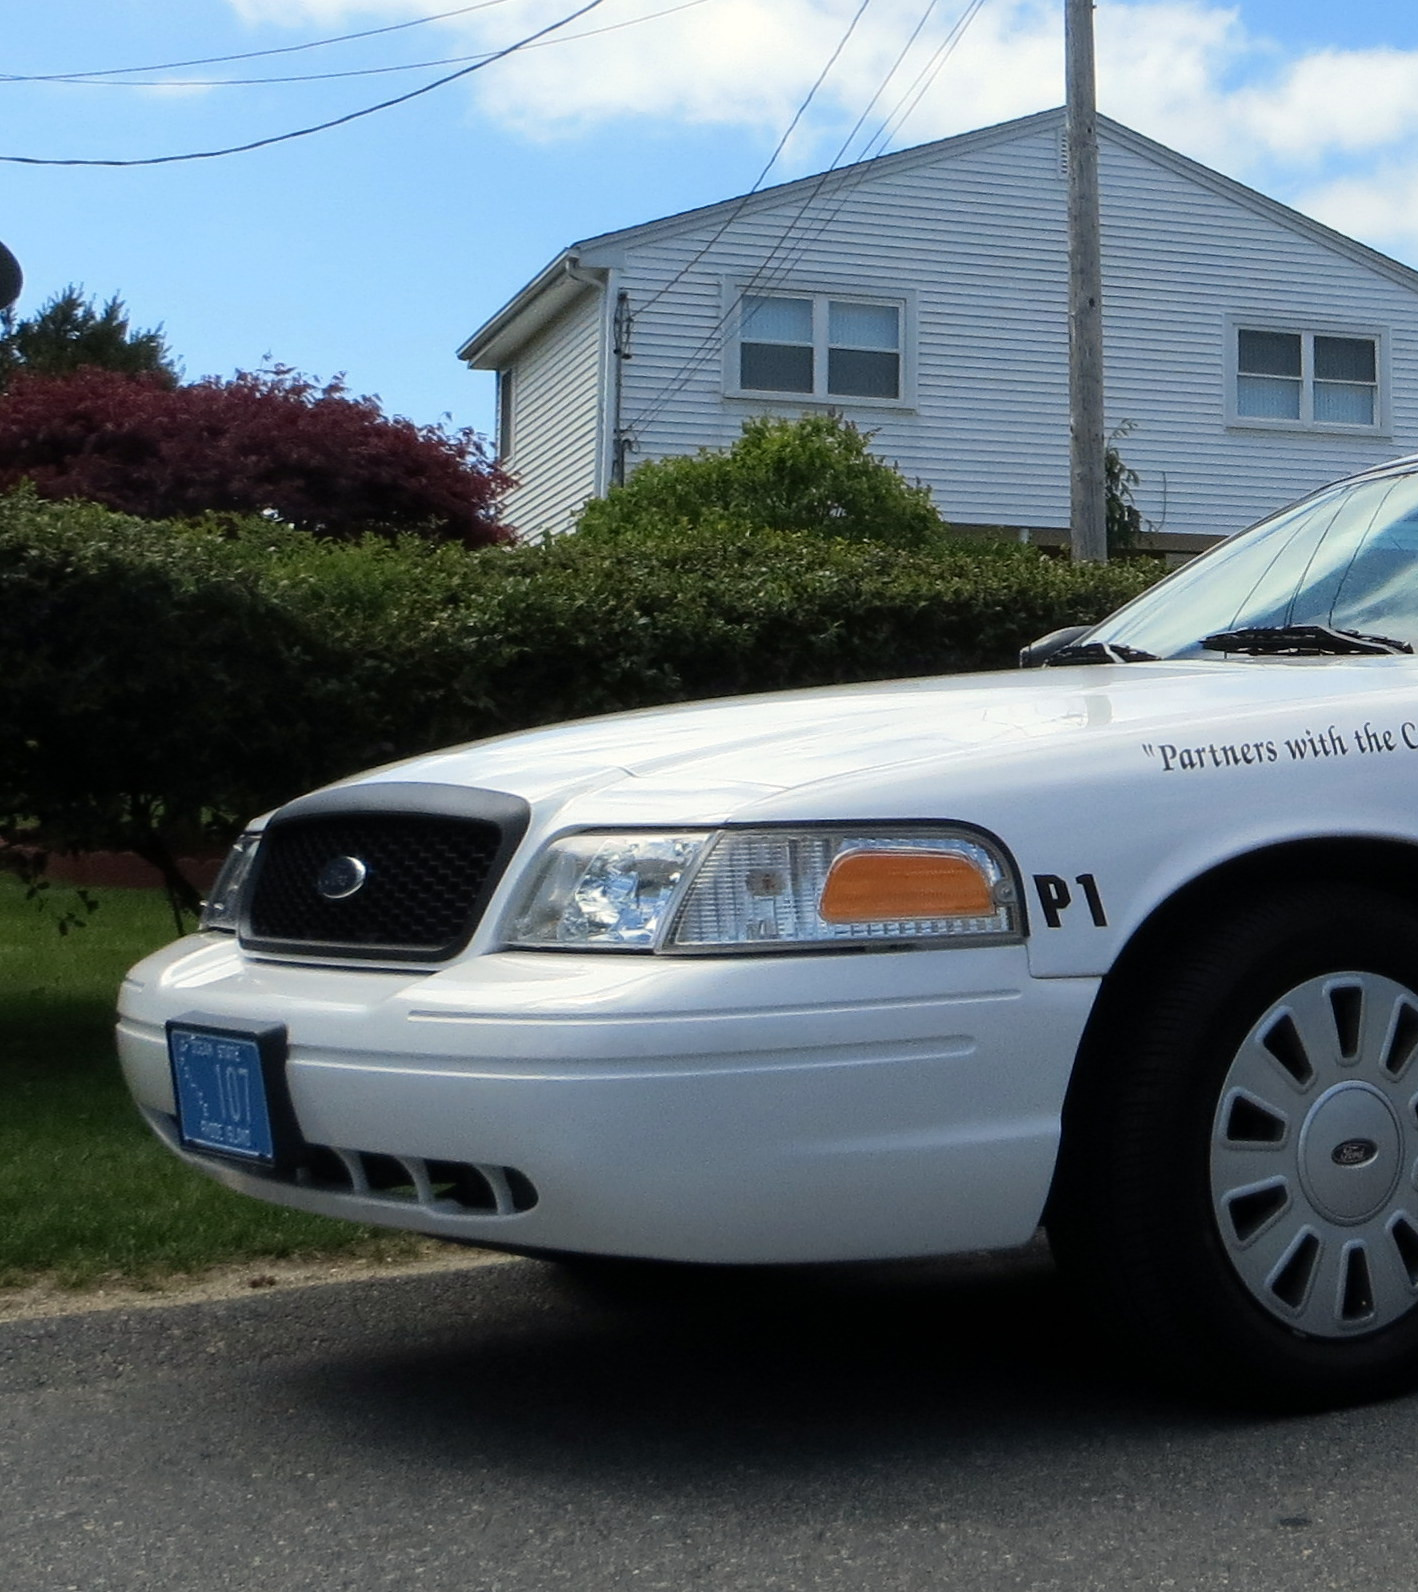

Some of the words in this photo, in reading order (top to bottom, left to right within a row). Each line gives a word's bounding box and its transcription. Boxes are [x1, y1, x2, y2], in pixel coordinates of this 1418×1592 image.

[1142, 743, 1278, 772] "Partners
[1284, 725, 1349, 760] with
[1354, 722, 1397, 755] the
[215, 1064, 251, 1122] 107
